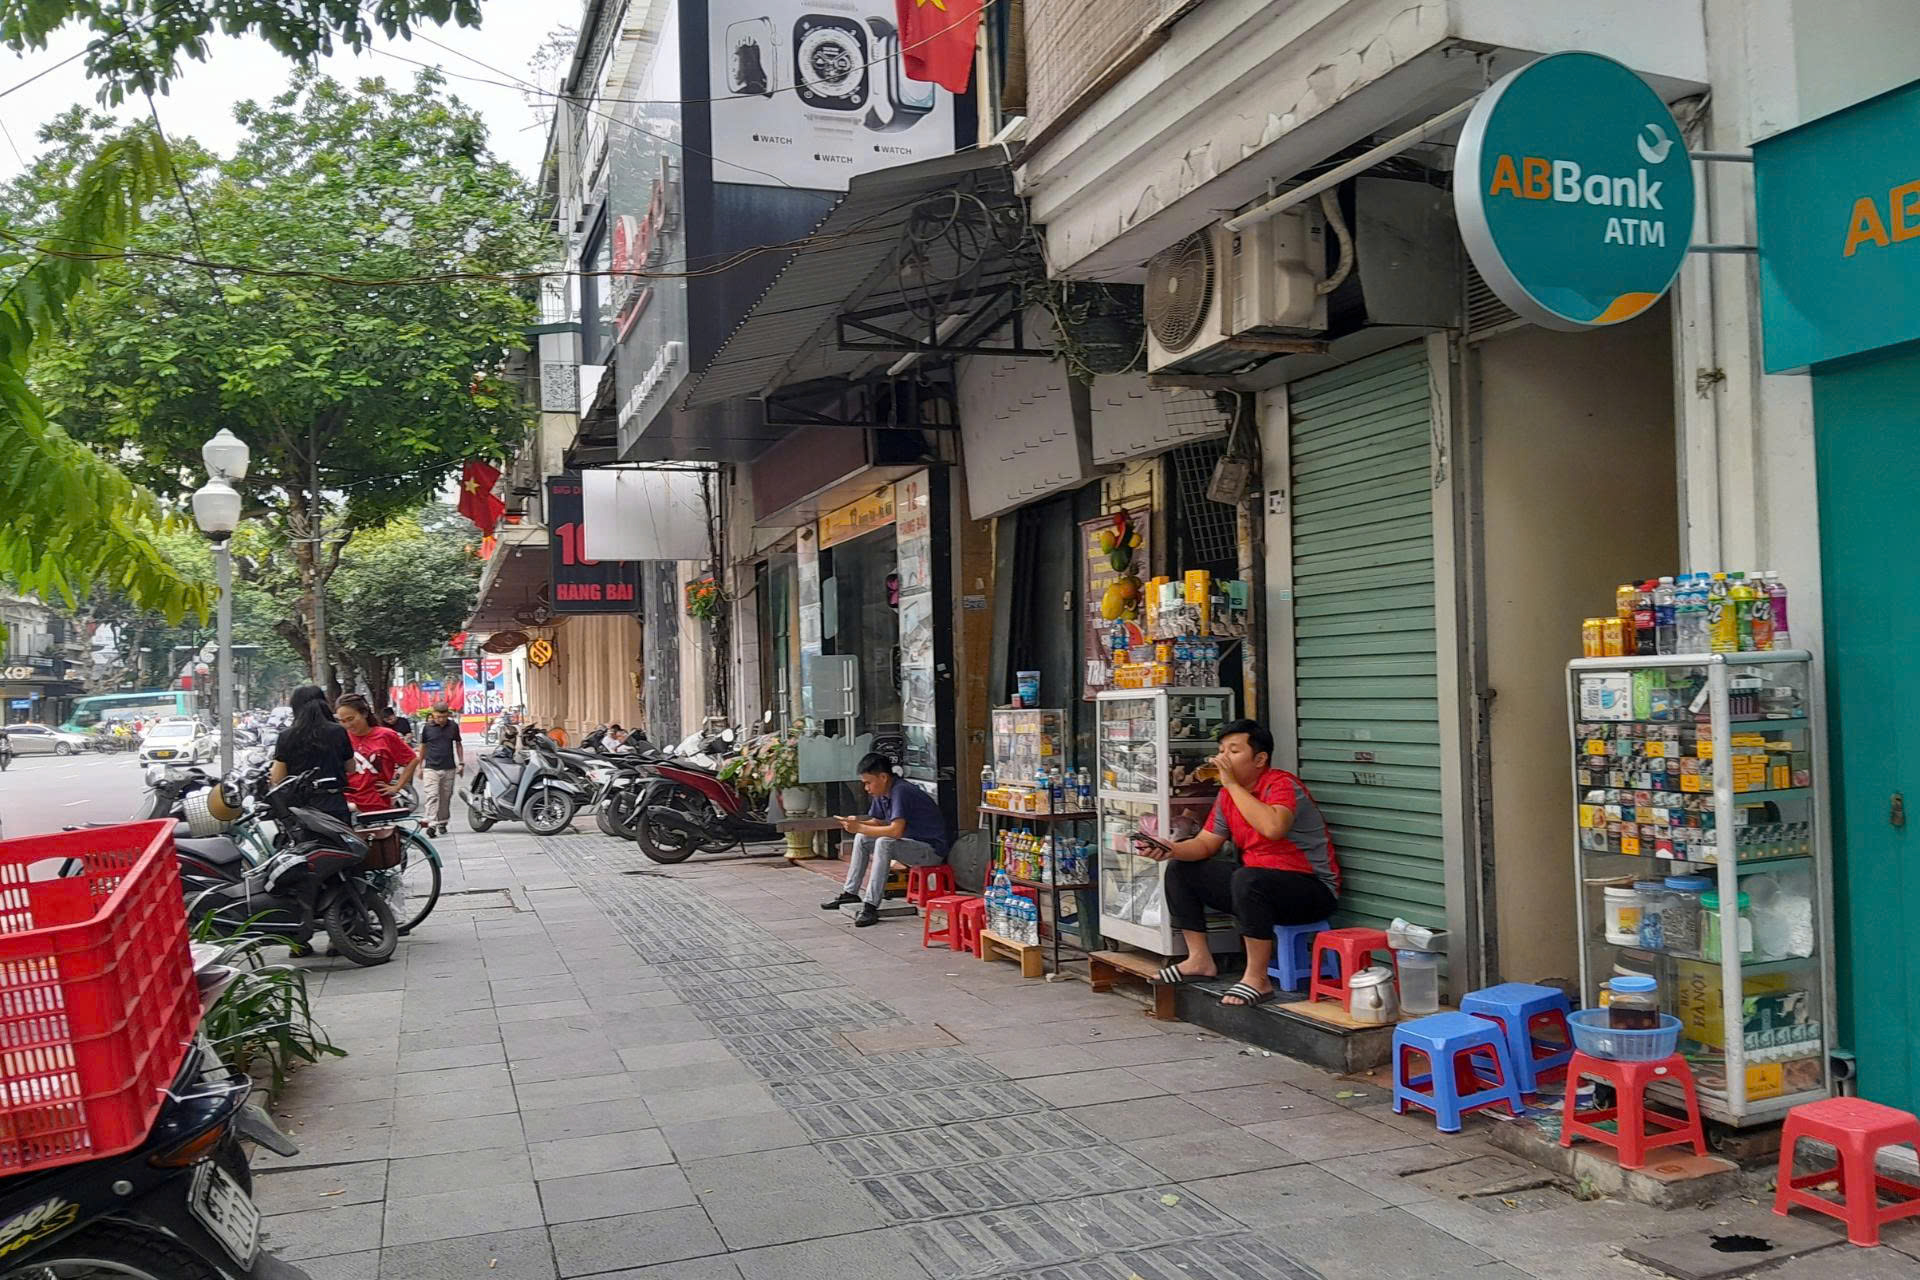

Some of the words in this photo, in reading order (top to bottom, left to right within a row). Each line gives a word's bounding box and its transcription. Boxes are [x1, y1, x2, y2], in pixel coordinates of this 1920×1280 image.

[760, 135, 793, 145] WATCH
[881, 146, 912, 155] WATCH
[822, 154, 853, 164] WATCH
[1489, 153, 1664, 211] ABBank
[1603, 217, 1666, 248] ATM
